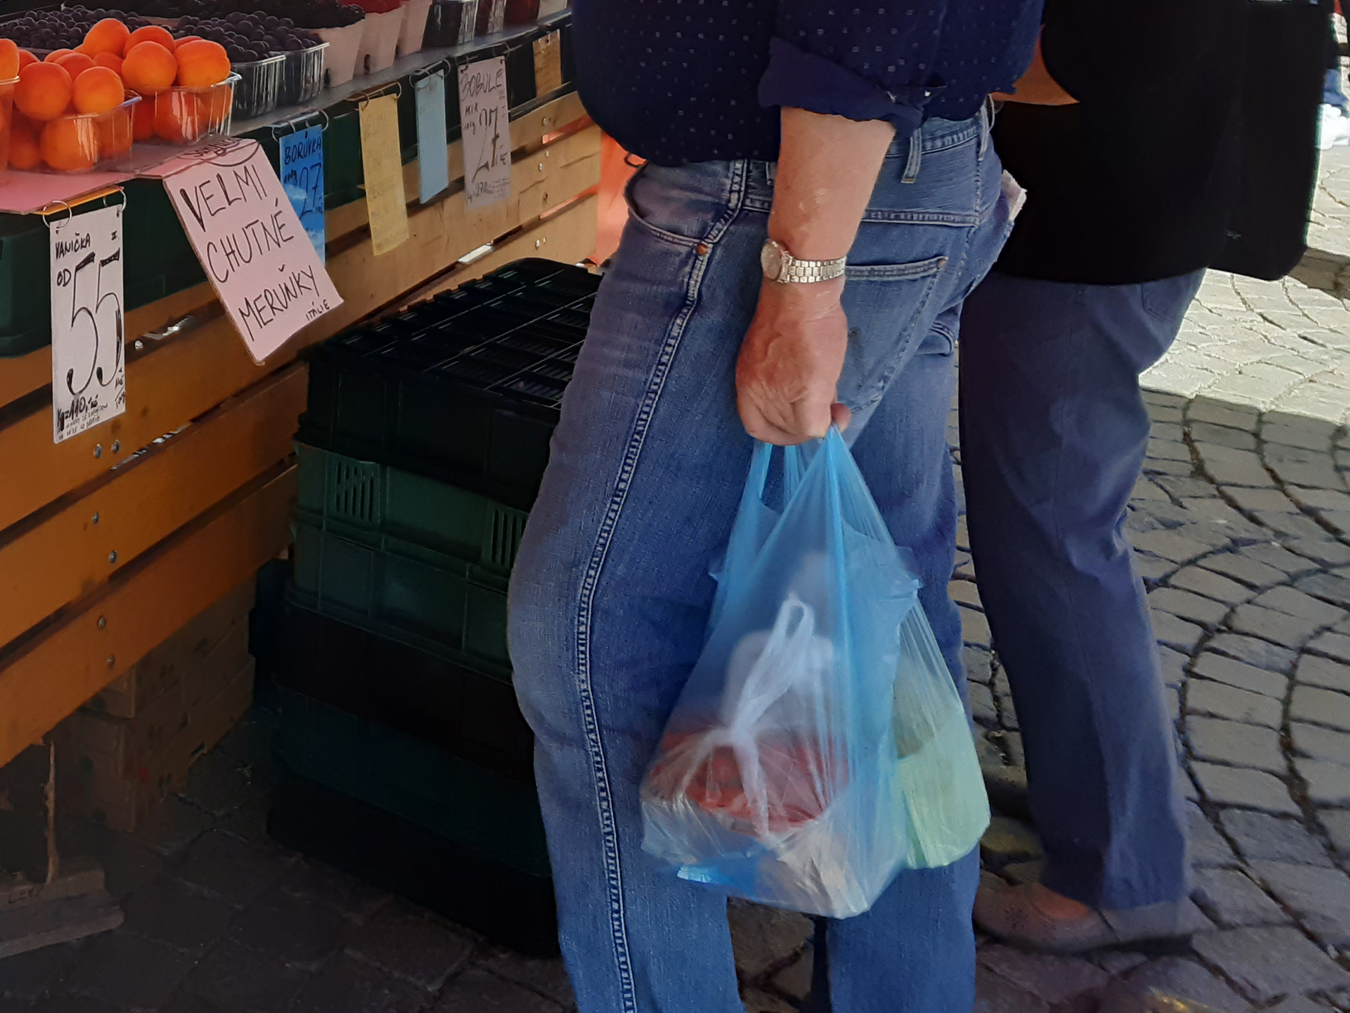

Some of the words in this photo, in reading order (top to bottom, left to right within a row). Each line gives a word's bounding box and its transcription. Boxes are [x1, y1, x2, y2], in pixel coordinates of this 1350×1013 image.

[179, 164, 268, 233] VELMI
[54, 232, 91, 260] VANIČKA
[206, 197, 295, 284] CHUTNÉ
[56, 268, 72, 288] OD
[66, 247, 124, 396] 55
[238, 264, 321, 342] MERUŇKY
[305, 298, 331, 322] ITÁLIE
